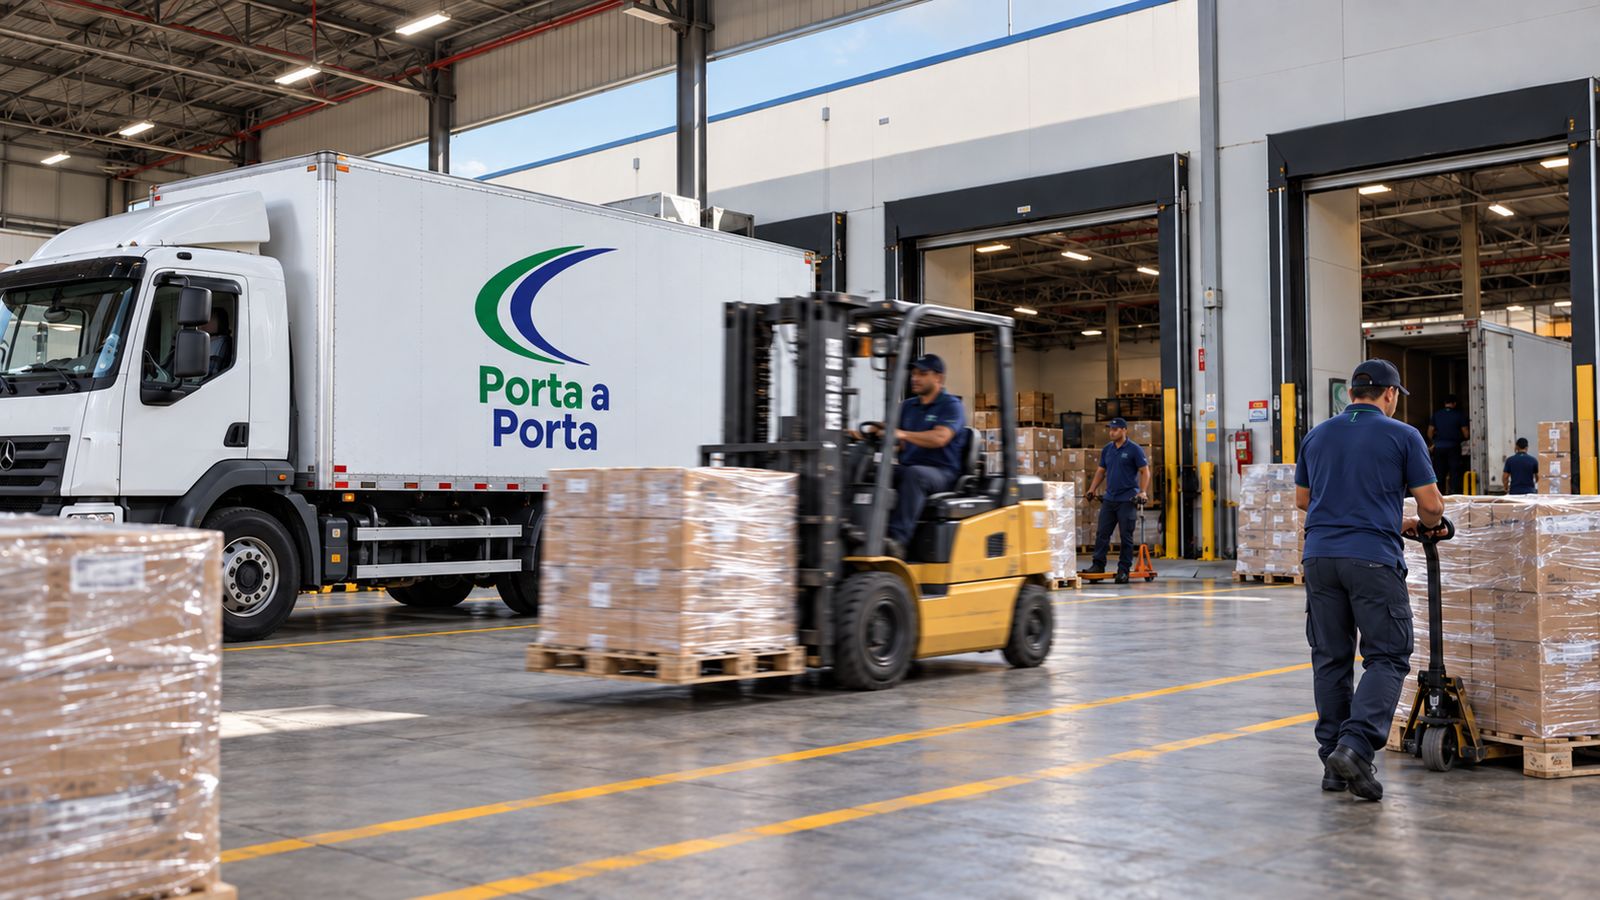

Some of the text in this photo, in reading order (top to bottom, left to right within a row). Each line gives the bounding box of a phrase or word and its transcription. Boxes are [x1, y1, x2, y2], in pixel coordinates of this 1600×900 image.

[479, 365, 610, 411] Porta a
[493, 408, 598, 451] Porta
